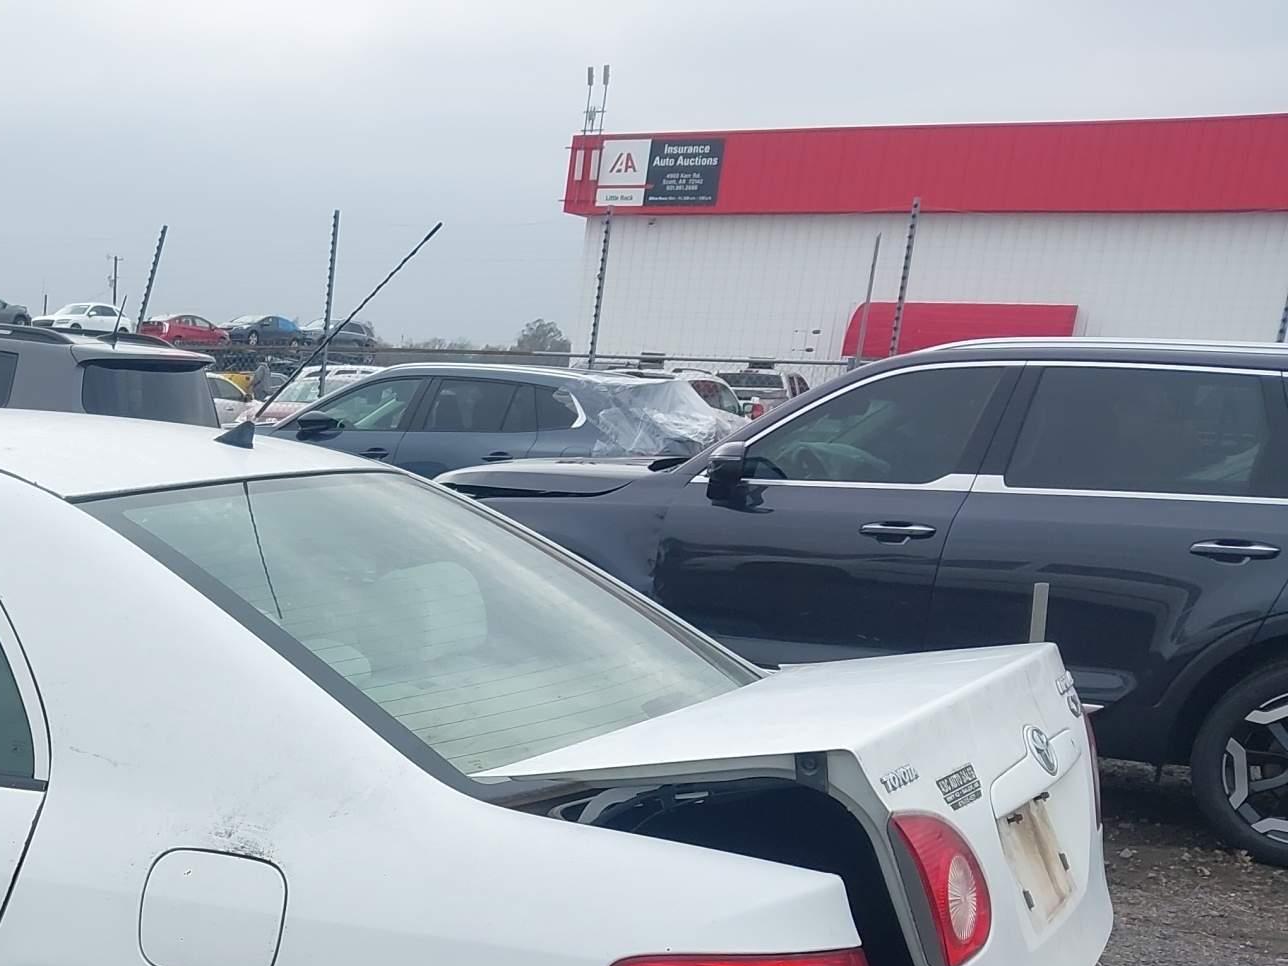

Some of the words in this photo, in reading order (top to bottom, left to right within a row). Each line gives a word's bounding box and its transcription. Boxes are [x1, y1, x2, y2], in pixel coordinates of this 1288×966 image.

[664, 143, 711, 154] Insurance
[652, 156, 675, 167] Auto
[676, 155, 719, 166] Auctions
[879, 764, 920, 794] TOYOTA
